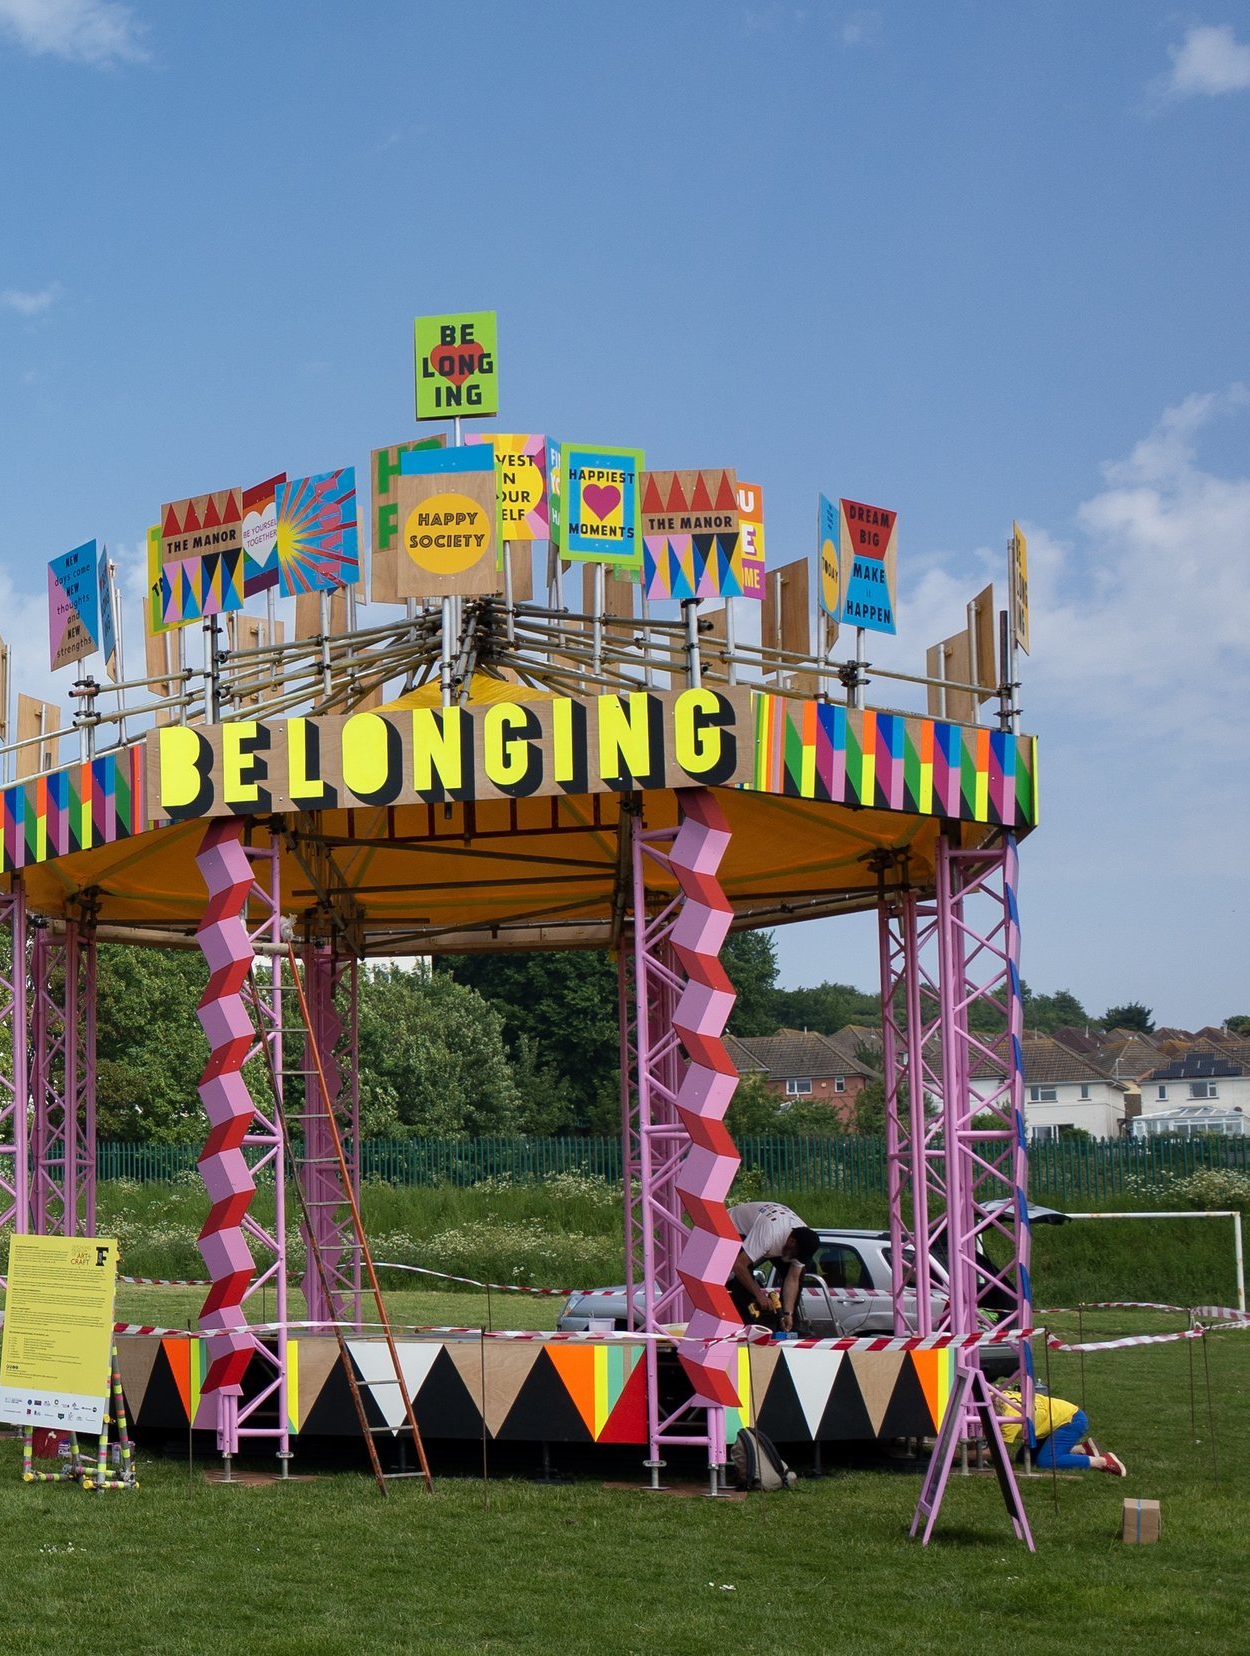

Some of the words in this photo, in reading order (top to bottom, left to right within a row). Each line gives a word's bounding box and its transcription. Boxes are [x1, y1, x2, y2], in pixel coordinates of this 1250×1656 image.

[440, 324, 475, 346] BE
[422, 353, 493, 378] LONG
[435, 384, 482, 407] ING
[495, 455, 535, 467] VEST
[503, 472, 516, 485] N
[569, 468, 635, 484] HAPPIEST
[496, 490, 531, 503] OUR
[418, 512, 479, 526] HAPPY
[502, 508, 525, 521] ELF
[648, 518, 675, 530] THE
[680, 516, 733, 530] MANOR
[849, 505, 890, 529] DREAM
[251, 518, 277, 535] YOURSEL
[568, 522, 635, 538] MOMENTS
[167, 539, 188, 554] THE
[192, 529, 237, 549] MANOR
[247, 529, 278, 548] TOGETHER
[409, 534, 486, 549] SOCIETY
[859, 529, 880, 547] BIG
[65, 553, 79, 569] NEW
[54, 574, 71, 587] days
[72, 564, 91, 578] come
[853, 562, 886, 584] MAKE
[66, 582, 80, 597] NEW
[57, 594, 90, 615] thoughts
[846, 600, 891, 624] HAPPEN
[67, 611, 80, 625] and
[67, 625, 81, 640] NEW
[57, 636, 92, 659] strengths
[159, 688, 736, 818] BELONGING
